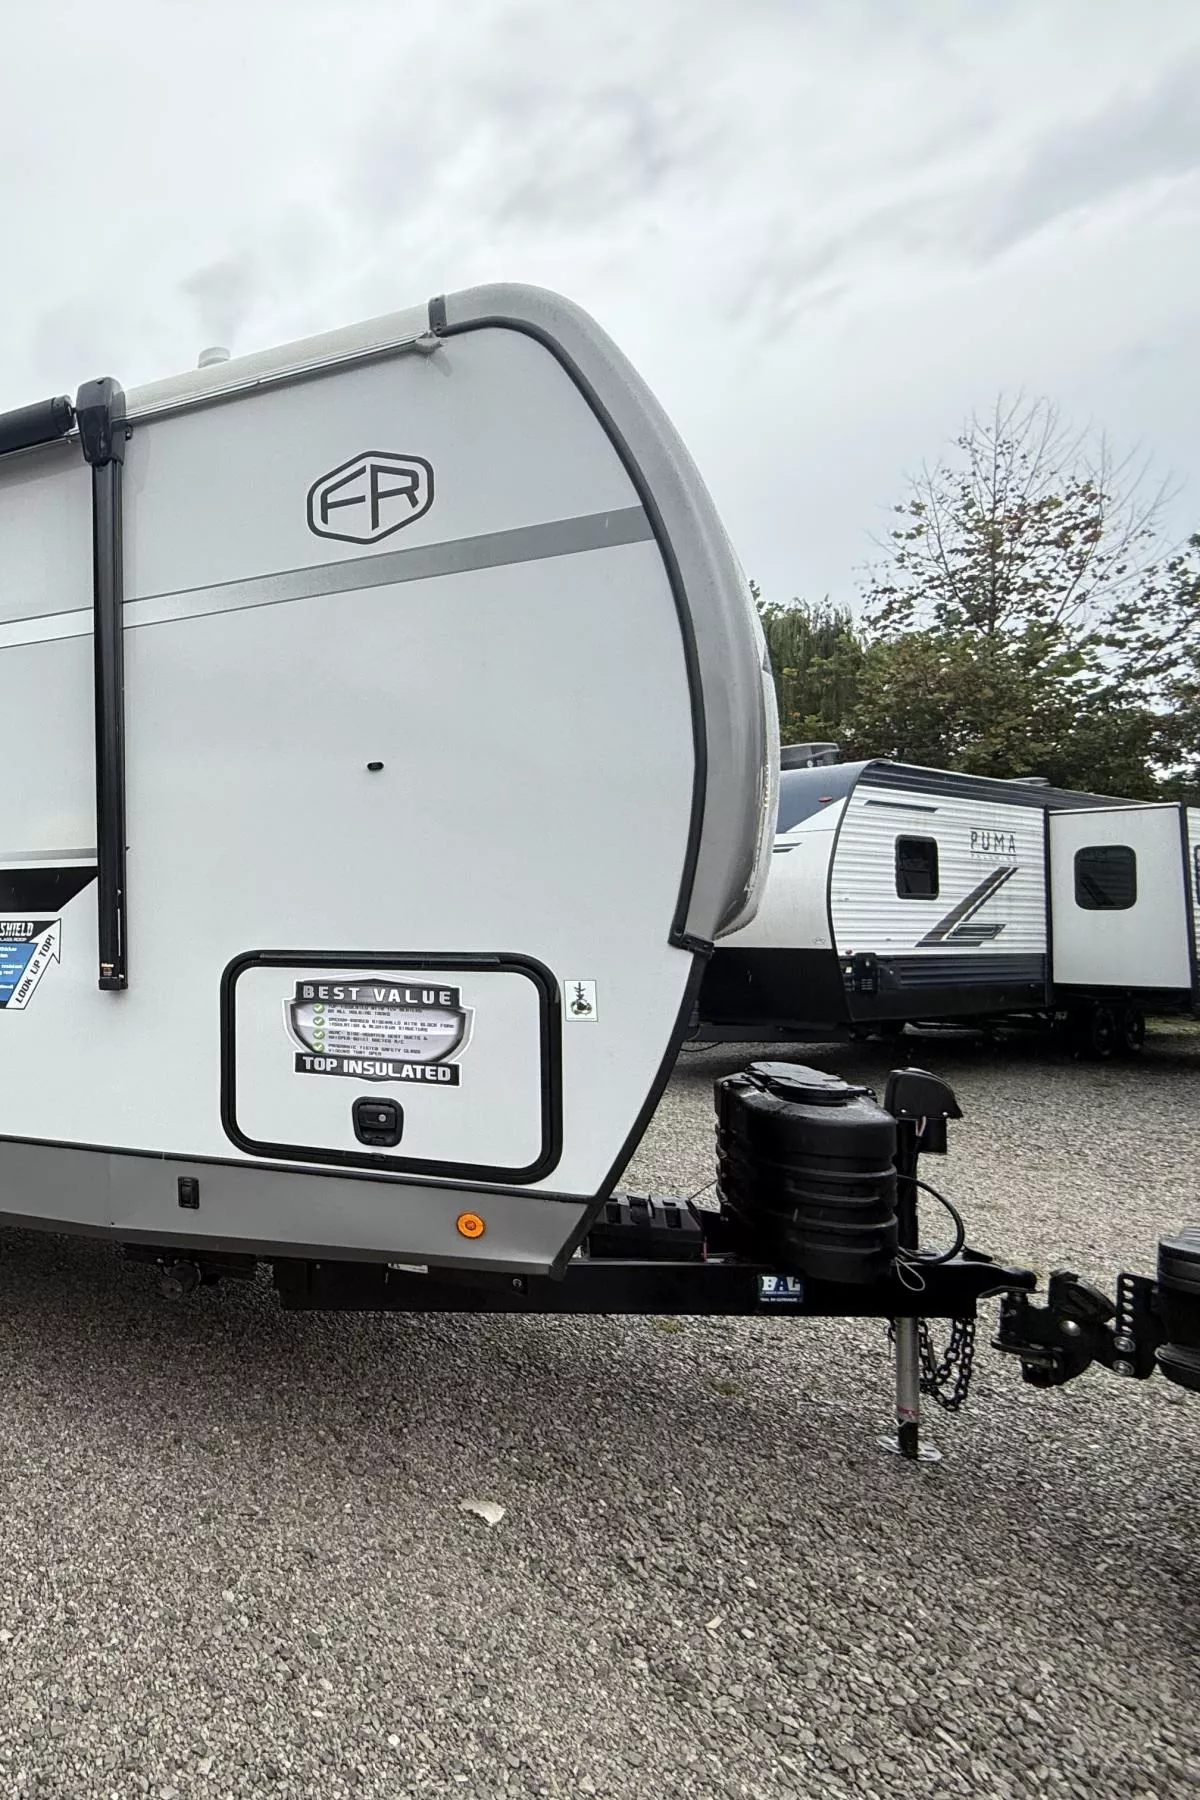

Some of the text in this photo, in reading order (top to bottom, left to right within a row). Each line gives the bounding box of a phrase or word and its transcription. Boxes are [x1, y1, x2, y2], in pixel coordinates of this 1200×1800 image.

[970, 831, 1016, 853] PUMA
[0, 922, 34, 937] SHIELD
[15, 934, 56, 1004] LOOK UP TOP!
[302, 986, 452, 1005] BEST VALUE
[302, 1056, 451, 1081] TOP INSULATED
